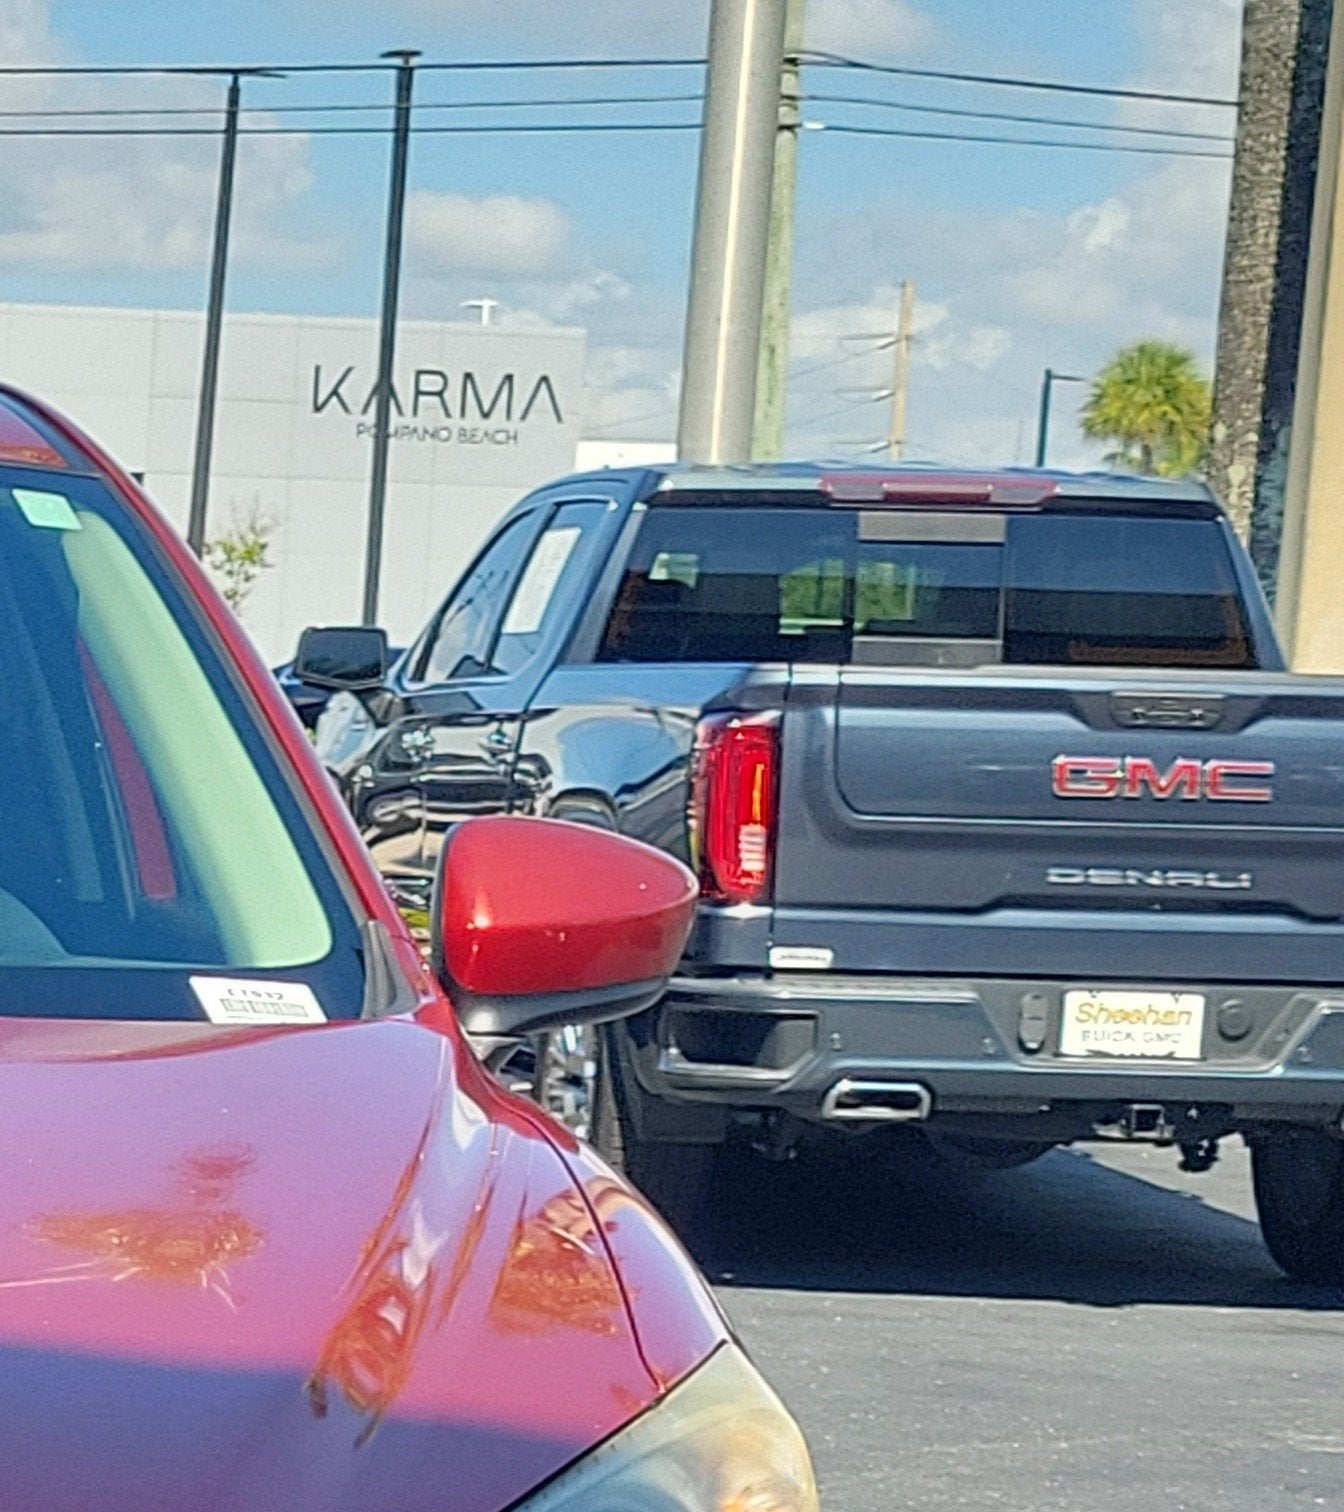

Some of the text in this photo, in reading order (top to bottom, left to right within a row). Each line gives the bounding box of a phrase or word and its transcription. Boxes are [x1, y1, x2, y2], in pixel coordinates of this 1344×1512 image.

[312, 364, 565, 424] KARMA
[458, 427, 518, 445] BEACH
[1052, 754, 1275, 801] GMC
[1046, 867, 1252, 889] DENALI
